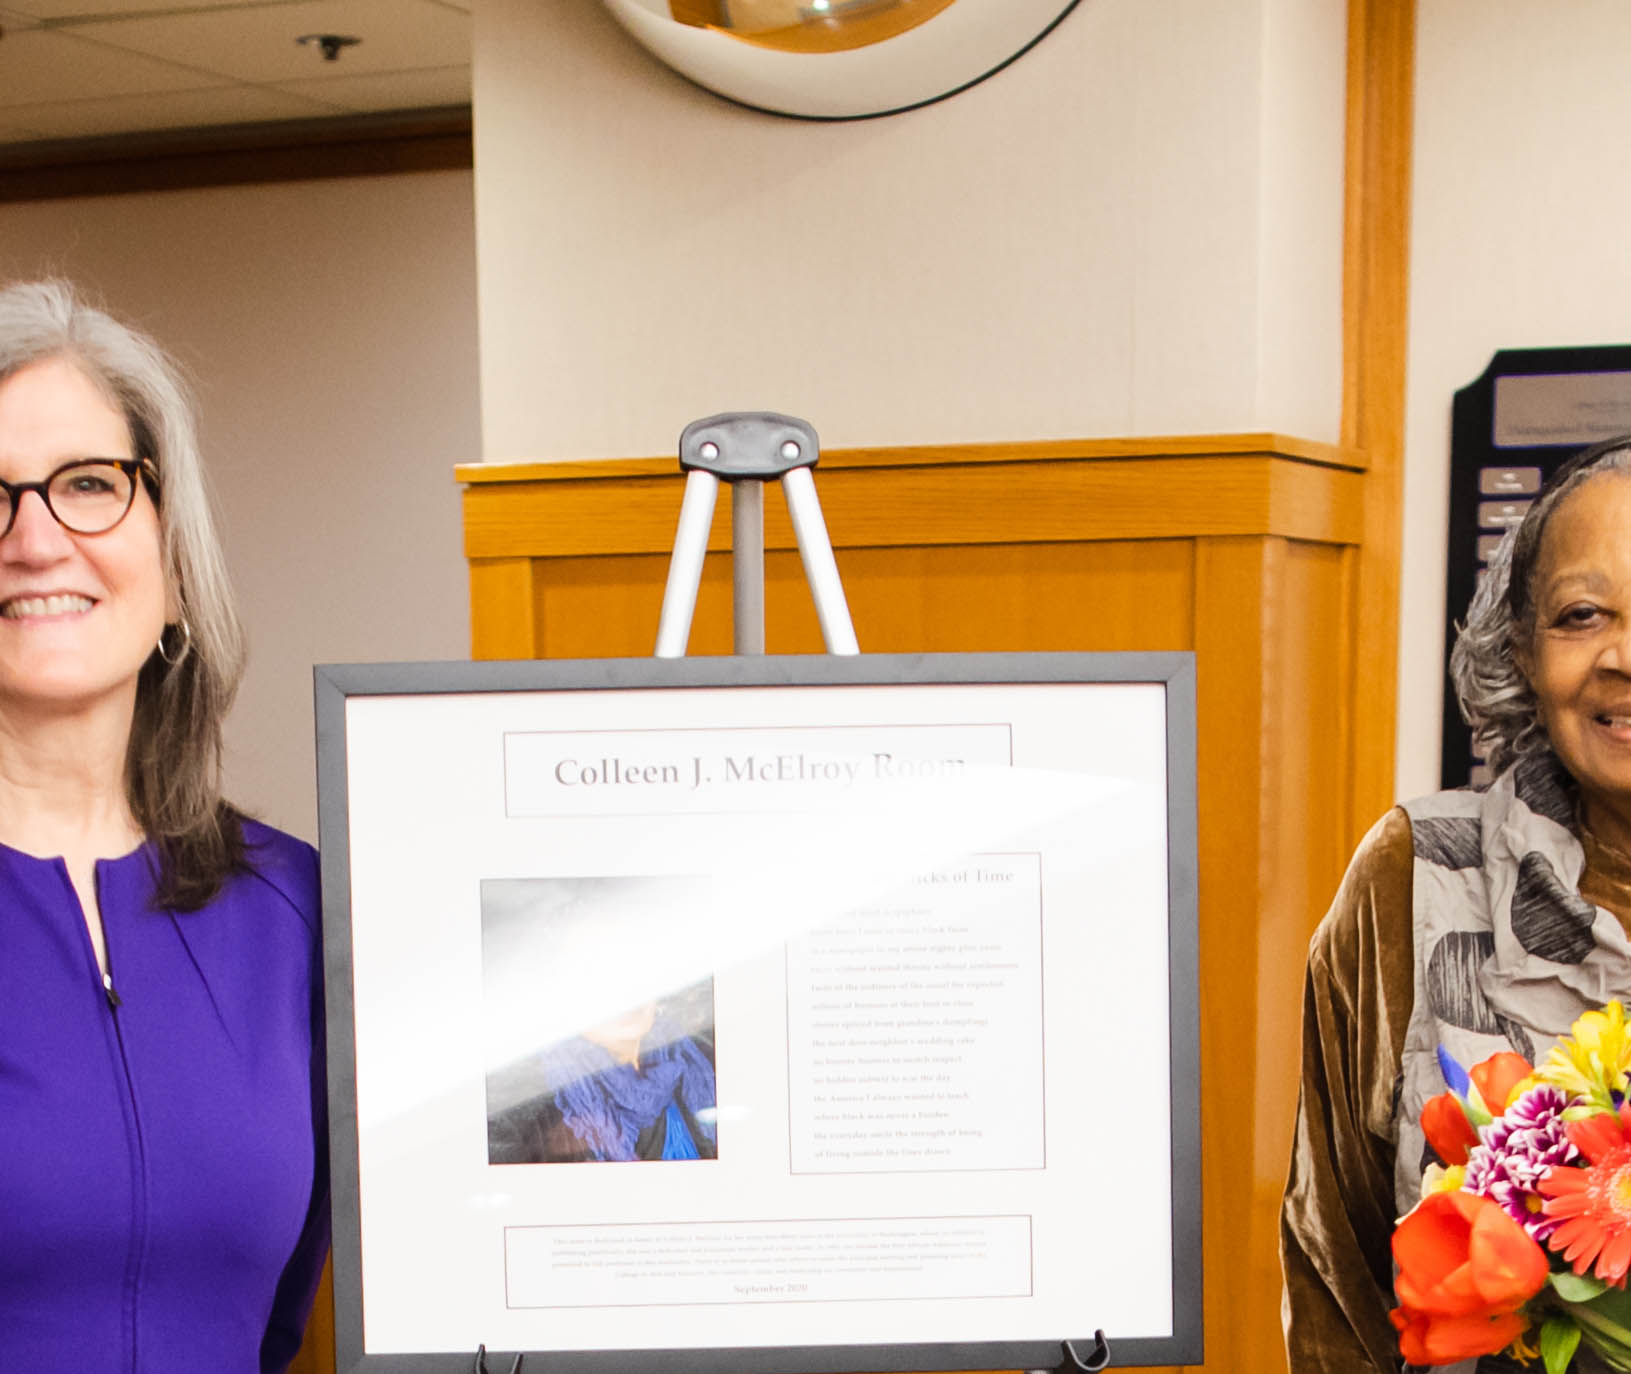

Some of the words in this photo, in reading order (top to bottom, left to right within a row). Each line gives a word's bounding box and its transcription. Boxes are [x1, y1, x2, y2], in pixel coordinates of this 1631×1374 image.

[554, 758, 680, 787] Colleen
[688, 757, 712, 788] J.
[723, 754, 863, 787] McElroy
